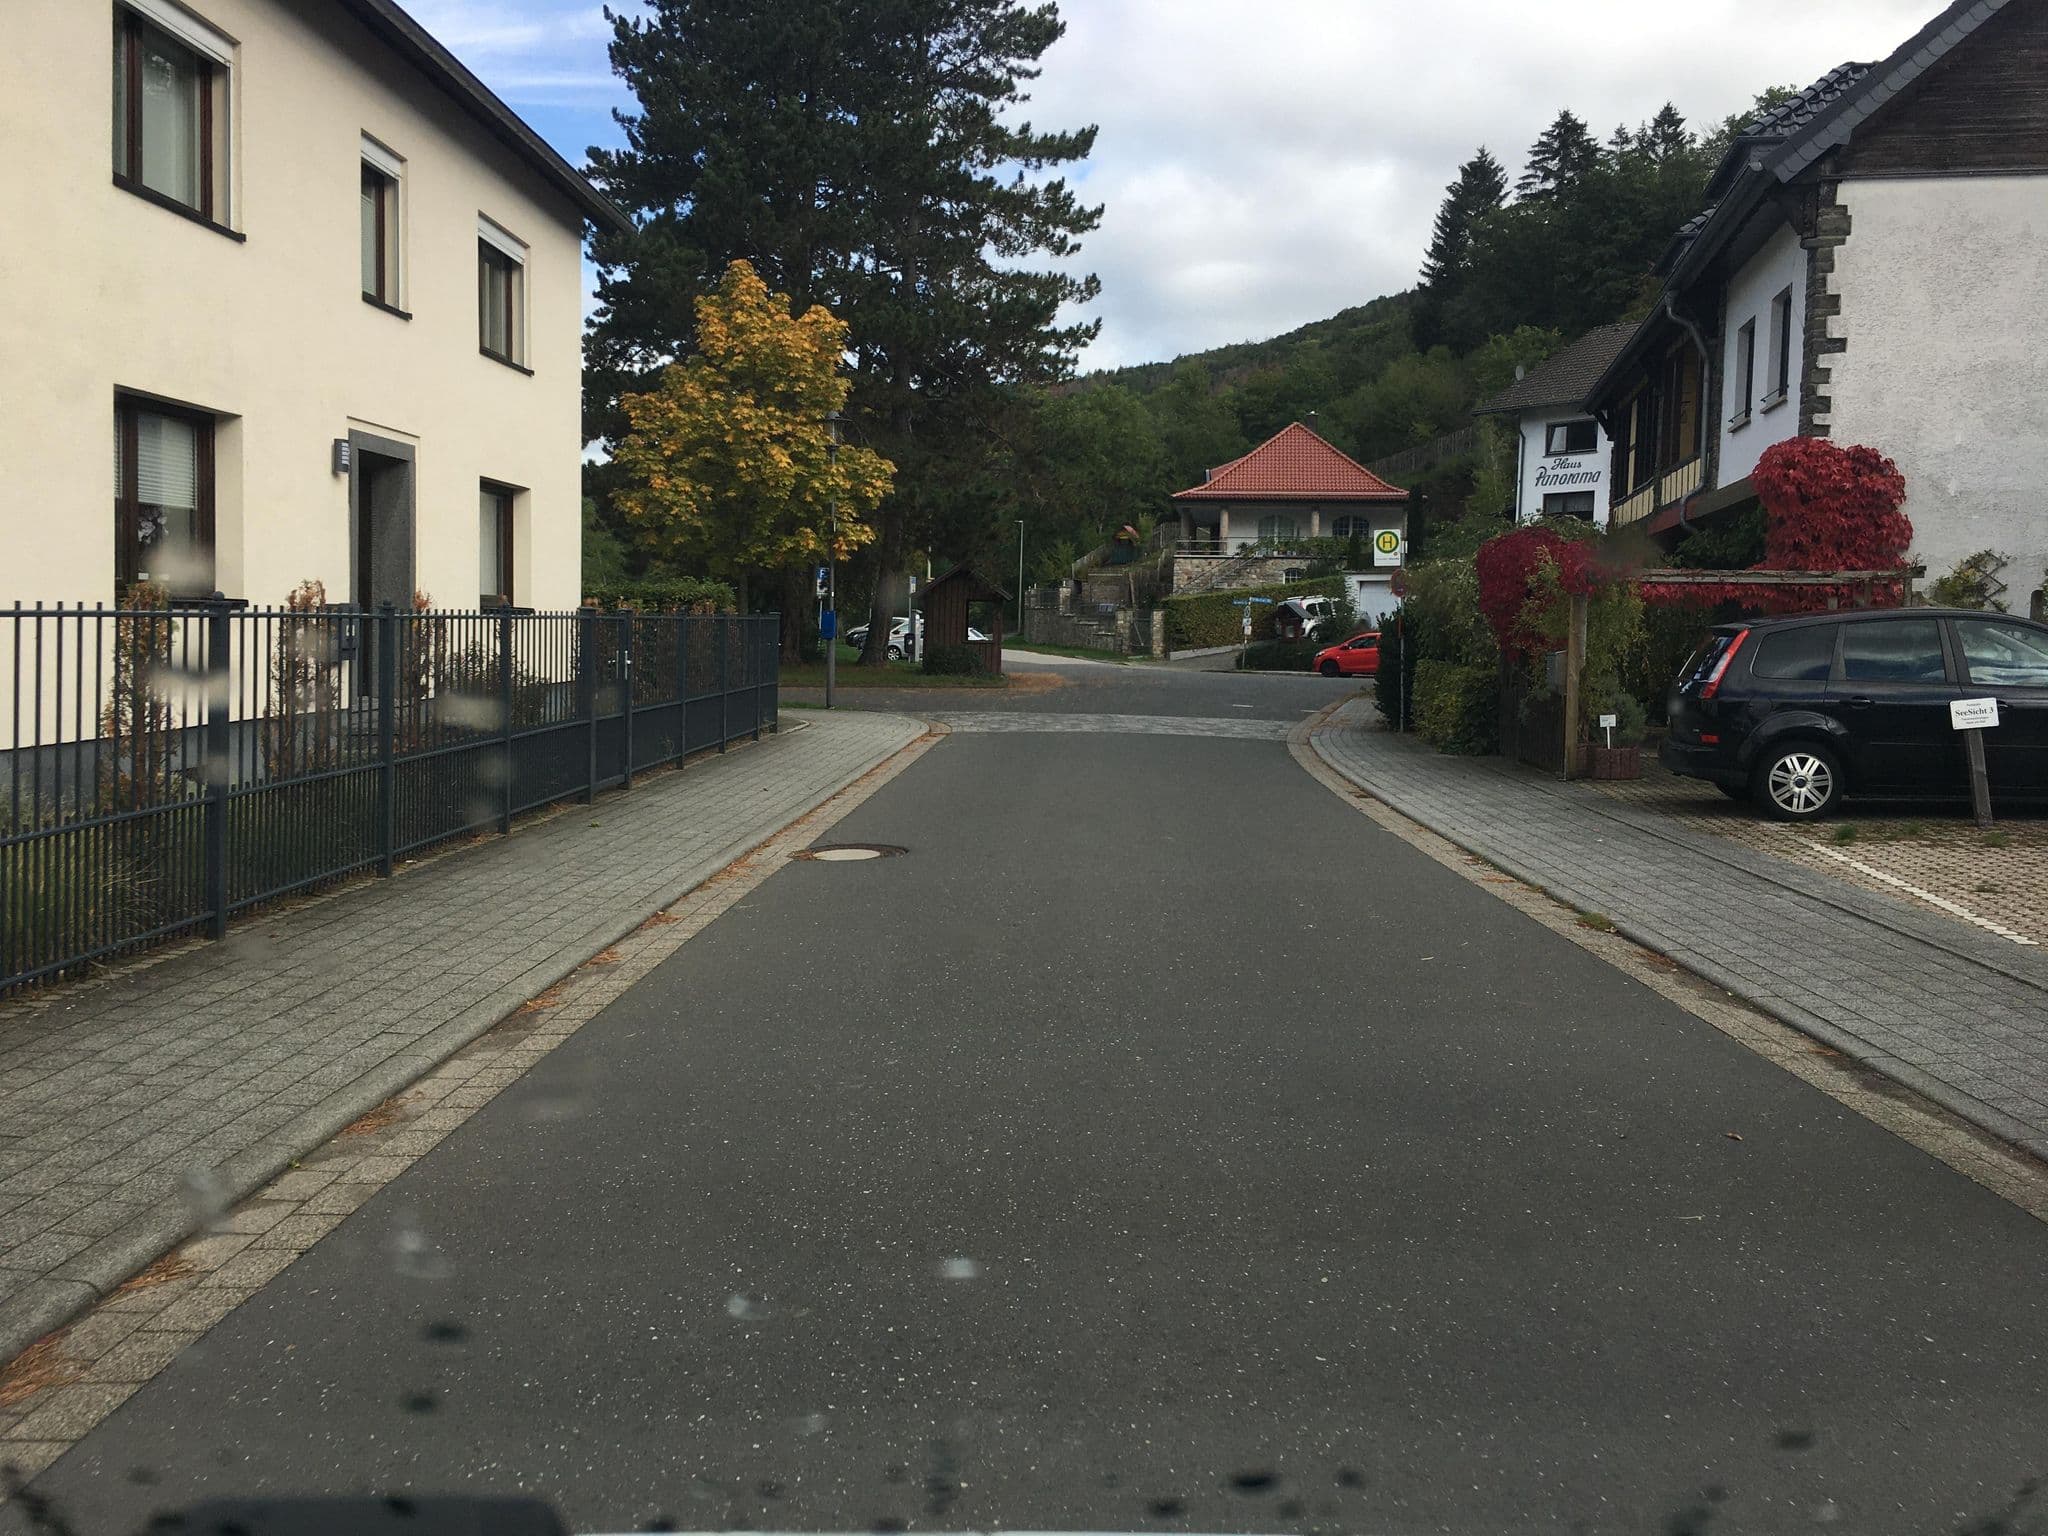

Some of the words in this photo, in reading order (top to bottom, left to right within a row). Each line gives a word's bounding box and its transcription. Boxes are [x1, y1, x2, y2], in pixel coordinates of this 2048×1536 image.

[1551, 458, 1582, 470] Haus
[1535, 466, 1602, 487] Panorama
[1382, 535, 1393, 549] H
[1954, 707, 1988, 717] SeeSicht
